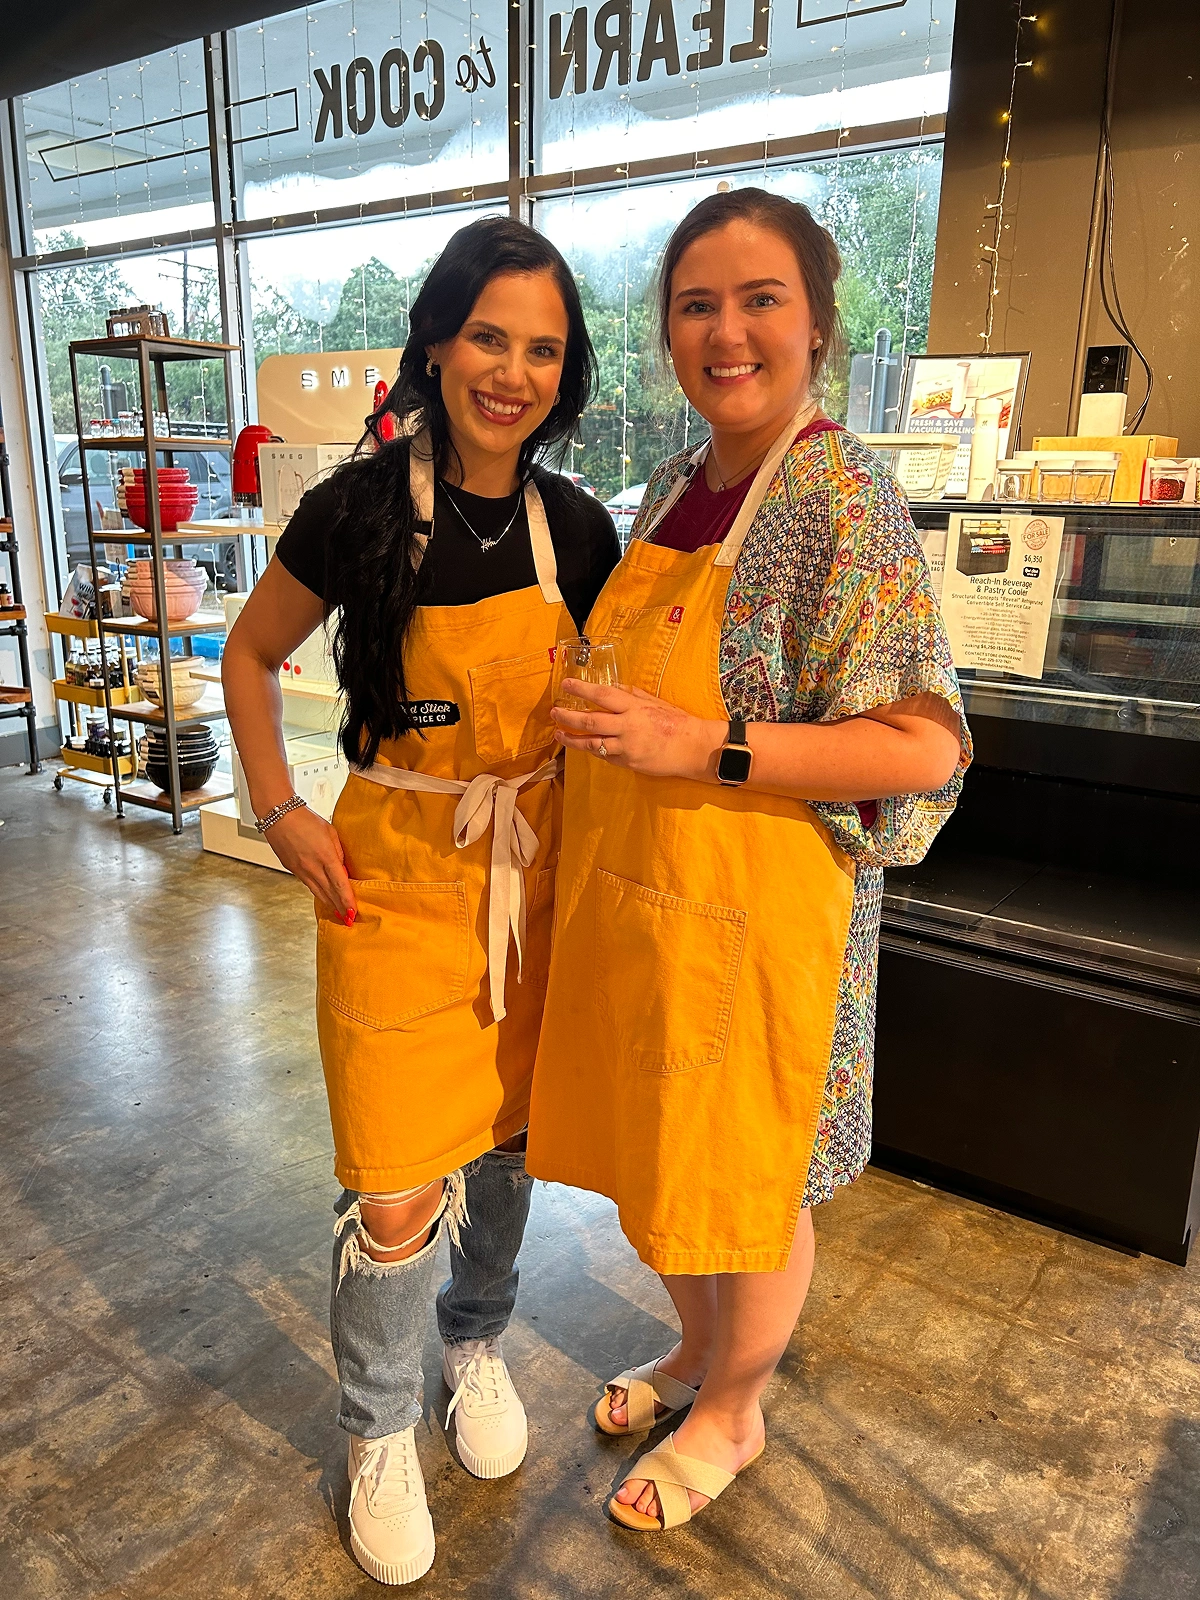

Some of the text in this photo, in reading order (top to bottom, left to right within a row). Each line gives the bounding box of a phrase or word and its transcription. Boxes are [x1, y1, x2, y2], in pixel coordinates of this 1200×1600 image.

[301, 368, 379, 390] SME
[910, 419, 964, 427] FRESH & SAVE
[1023, 529, 1049, 540] FOR SALE
[970, 576, 1033, 589] Reach-In Beverage
[976, 585, 1029, 597] & Pastry Cooler
[977, 594, 999, 602] Concepts
[420, 702, 451, 714] Stick
[408, 715, 434, 723] PICE
[303, 763, 339, 776] SMEG
